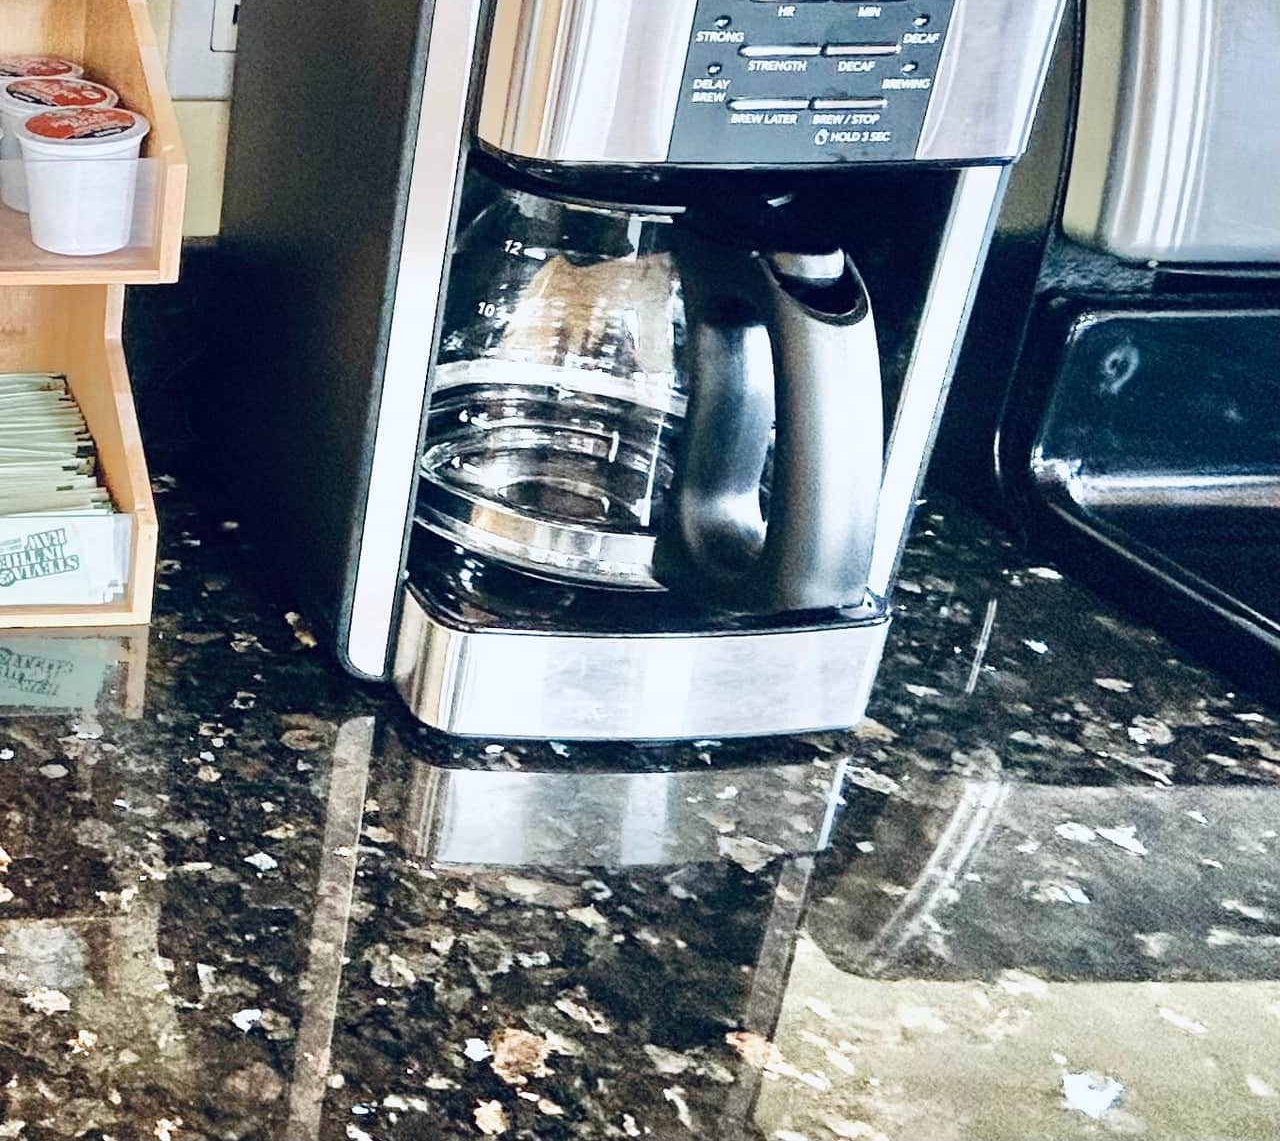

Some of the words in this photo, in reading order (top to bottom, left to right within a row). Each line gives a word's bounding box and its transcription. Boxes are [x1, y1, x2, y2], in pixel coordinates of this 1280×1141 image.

[777, 5, 796, 17] HR
[857, 6, 882, 17] MIN
[695, 30, 745, 43] STRONG
[902, 32, 940, 44] DECAF
[747, 60, 808, 72] STRENGTH
[836, 60, 876, 72] DECAF
[692, 79, 731, 90] DELAY
[881, 78, 931, 90] BREWING
[692, 91, 726, 103] BREW
[729, 114, 764, 125] BREW
[763, 114, 799, 125] LATER
[812, 113, 843, 125] BREW
[851, 113, 881, 125] STOP
[830, 131, 860, 143] HOLD
[869, 131, 892, 142] SEC
[504, 239, 523, 256] 12
[478, 301, 496, 318] 10
[24, 527, 68, 550] RAW
[41, 543, 65, 561] IN
[10, 554, 80, 581] STEVIA
